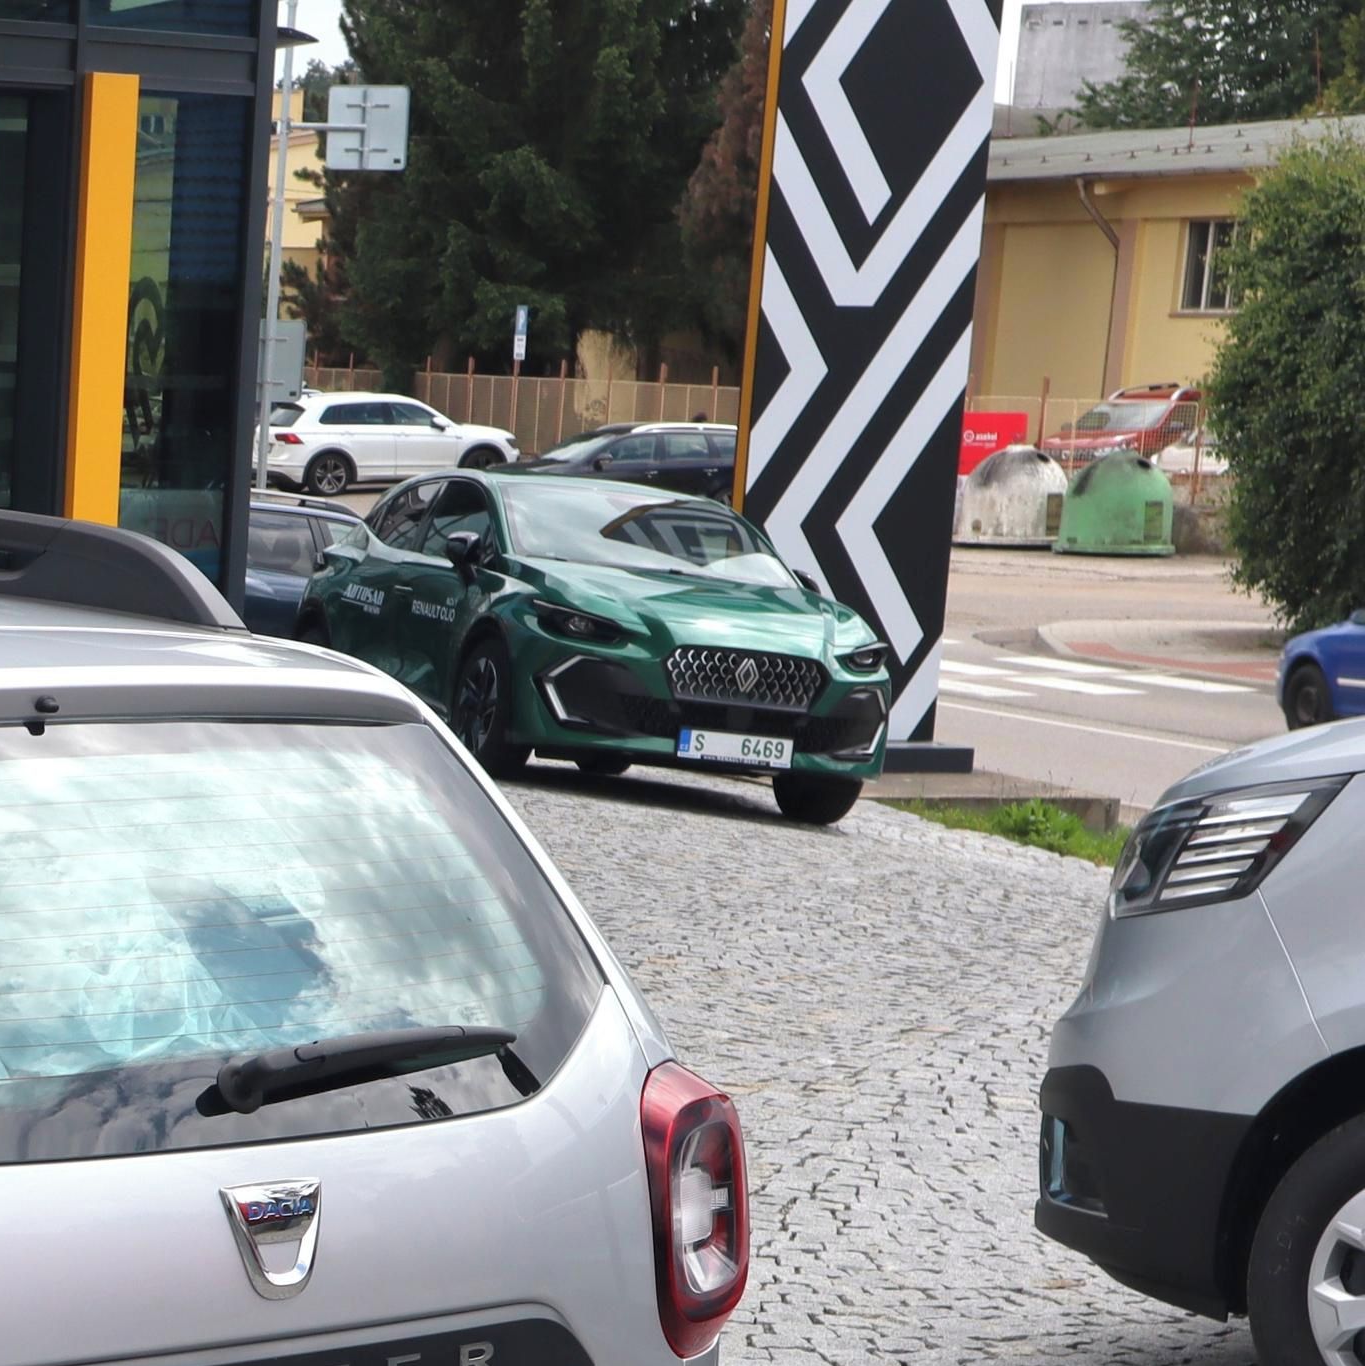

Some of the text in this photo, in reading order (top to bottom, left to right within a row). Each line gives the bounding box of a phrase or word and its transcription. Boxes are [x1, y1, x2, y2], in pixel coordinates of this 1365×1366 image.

[411, 600, 456, 622] RENAULT CLIO
[694, 733, 784, 759] S 6469
[247, 1197, 314, 1220] DACIA
